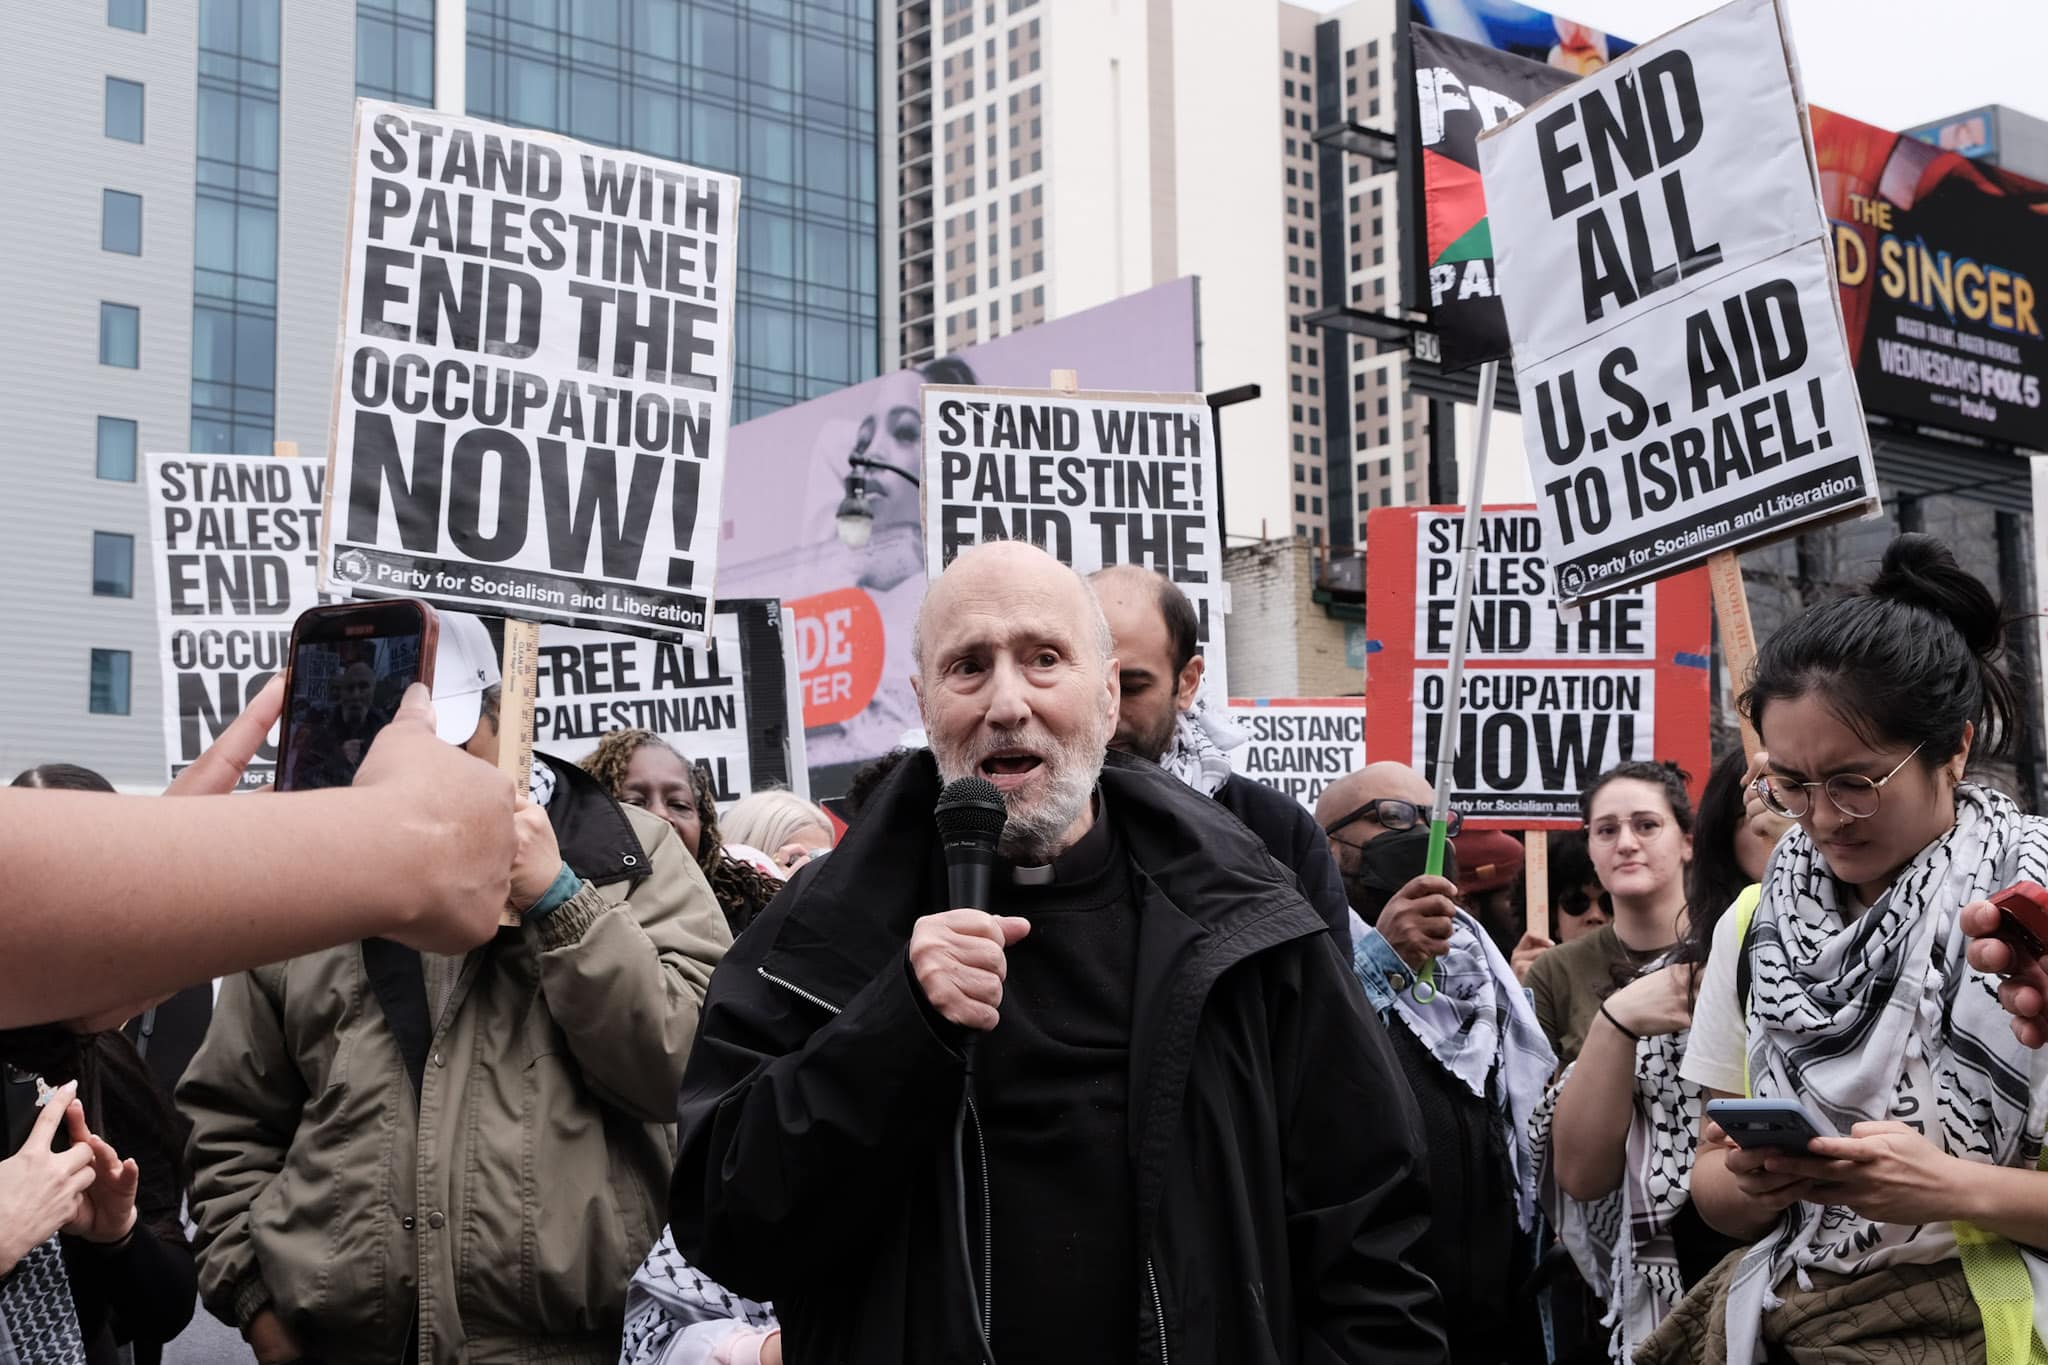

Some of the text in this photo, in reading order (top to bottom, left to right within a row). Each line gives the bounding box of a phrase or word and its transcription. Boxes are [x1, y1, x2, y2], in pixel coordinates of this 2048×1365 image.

[1535, 48, 1704, 220] END
[370, 113, 720, 236] STAND WITH
[367, 176, 719, 302] PALESTINE!
[1850, 194, 1893, 230] THE
[1576, 170, 1723, 324] ALL
[1830, 223, 2041, 336] D SINGER
[360, 245, 719, 393] END THE
[1534, 277, 1810, 467] U.S. AID
[1878, 339, 1980, 393] WEDNESDAYS
[351, 345, 712, 460] OCCUPATION
[938, 399, 1202, 458] STAND WITH
[160, 460, 292, 504] STAND
[940, 450, 1204, 512] PALESTINE!
[1545, 376, 1835, 547] TO ISRAEL!
[345, 409, 702, 590] NOW!
[1588, 556, 1627, 581] Party
[1628, 548, 1651, 565] for
[1653, 519, 1731, 557] Socialism
[1734, 505, 1766, 529] and
[1767, 474, 1857, 517] Liberation
[1090, 511, 1209, 584] THE
[1427, 517, 1541, 554] STAND
[167, 554, 291, 617] END
[377, 564, 431, 590] Party
[434, 574, 466, 592] for
[470, 577, 565, 605] Socialism
[569, 592, 607, 611] and
[611, 595, 704, 625] Liberation
[1428, 557, 1549, 597] PALES
[1426, 599, 1645, 654] END THE
[535, 641, 641, 698] FREE
[651, 636, 733, 691] ALL
[533, 694, 737, 742] PALESTINIAN
[1237, 715, 1366, 742] SISTANC
[242, 772, 265, 784] for
[1245, 746, 1354, 773] AGAINST
[1425, 712, 1635, 792] NOW!
[1449, 801, 1473, 812] arty
[1476, 799, 1494, 811] for
[1495, 799, 1554, 811] Socialism
